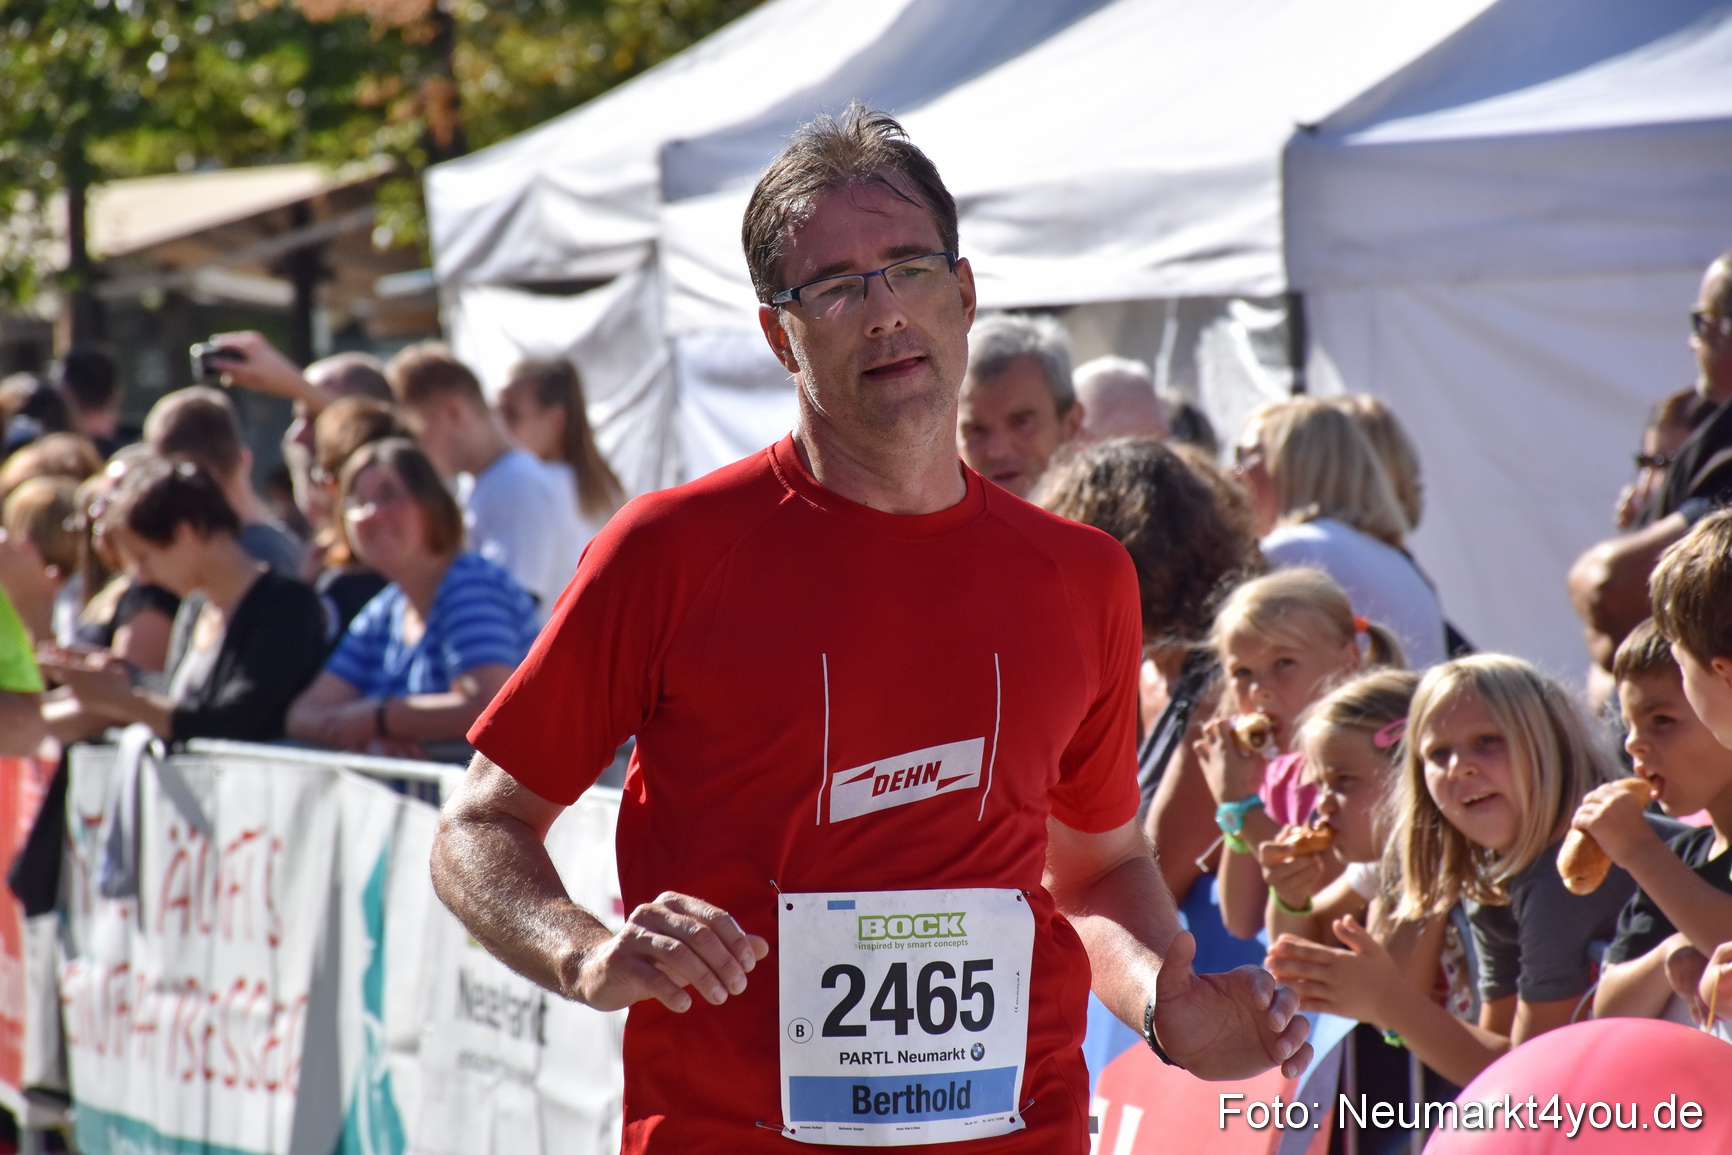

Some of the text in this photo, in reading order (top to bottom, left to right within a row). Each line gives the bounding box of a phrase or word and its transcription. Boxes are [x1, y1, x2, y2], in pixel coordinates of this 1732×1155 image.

[871, 760, 943, 798] DEHN
[858, 912, 968, 941] BOCK
[858, 939, 969, 952] inspired by smart concepts
[820, 958, 995, 1038] 2465
[795, 1025, 805, 1038] B
[839, 1048, 966, 1066] PARTL Neumarkt
[852, 1079, 972, 1115] Berthold
